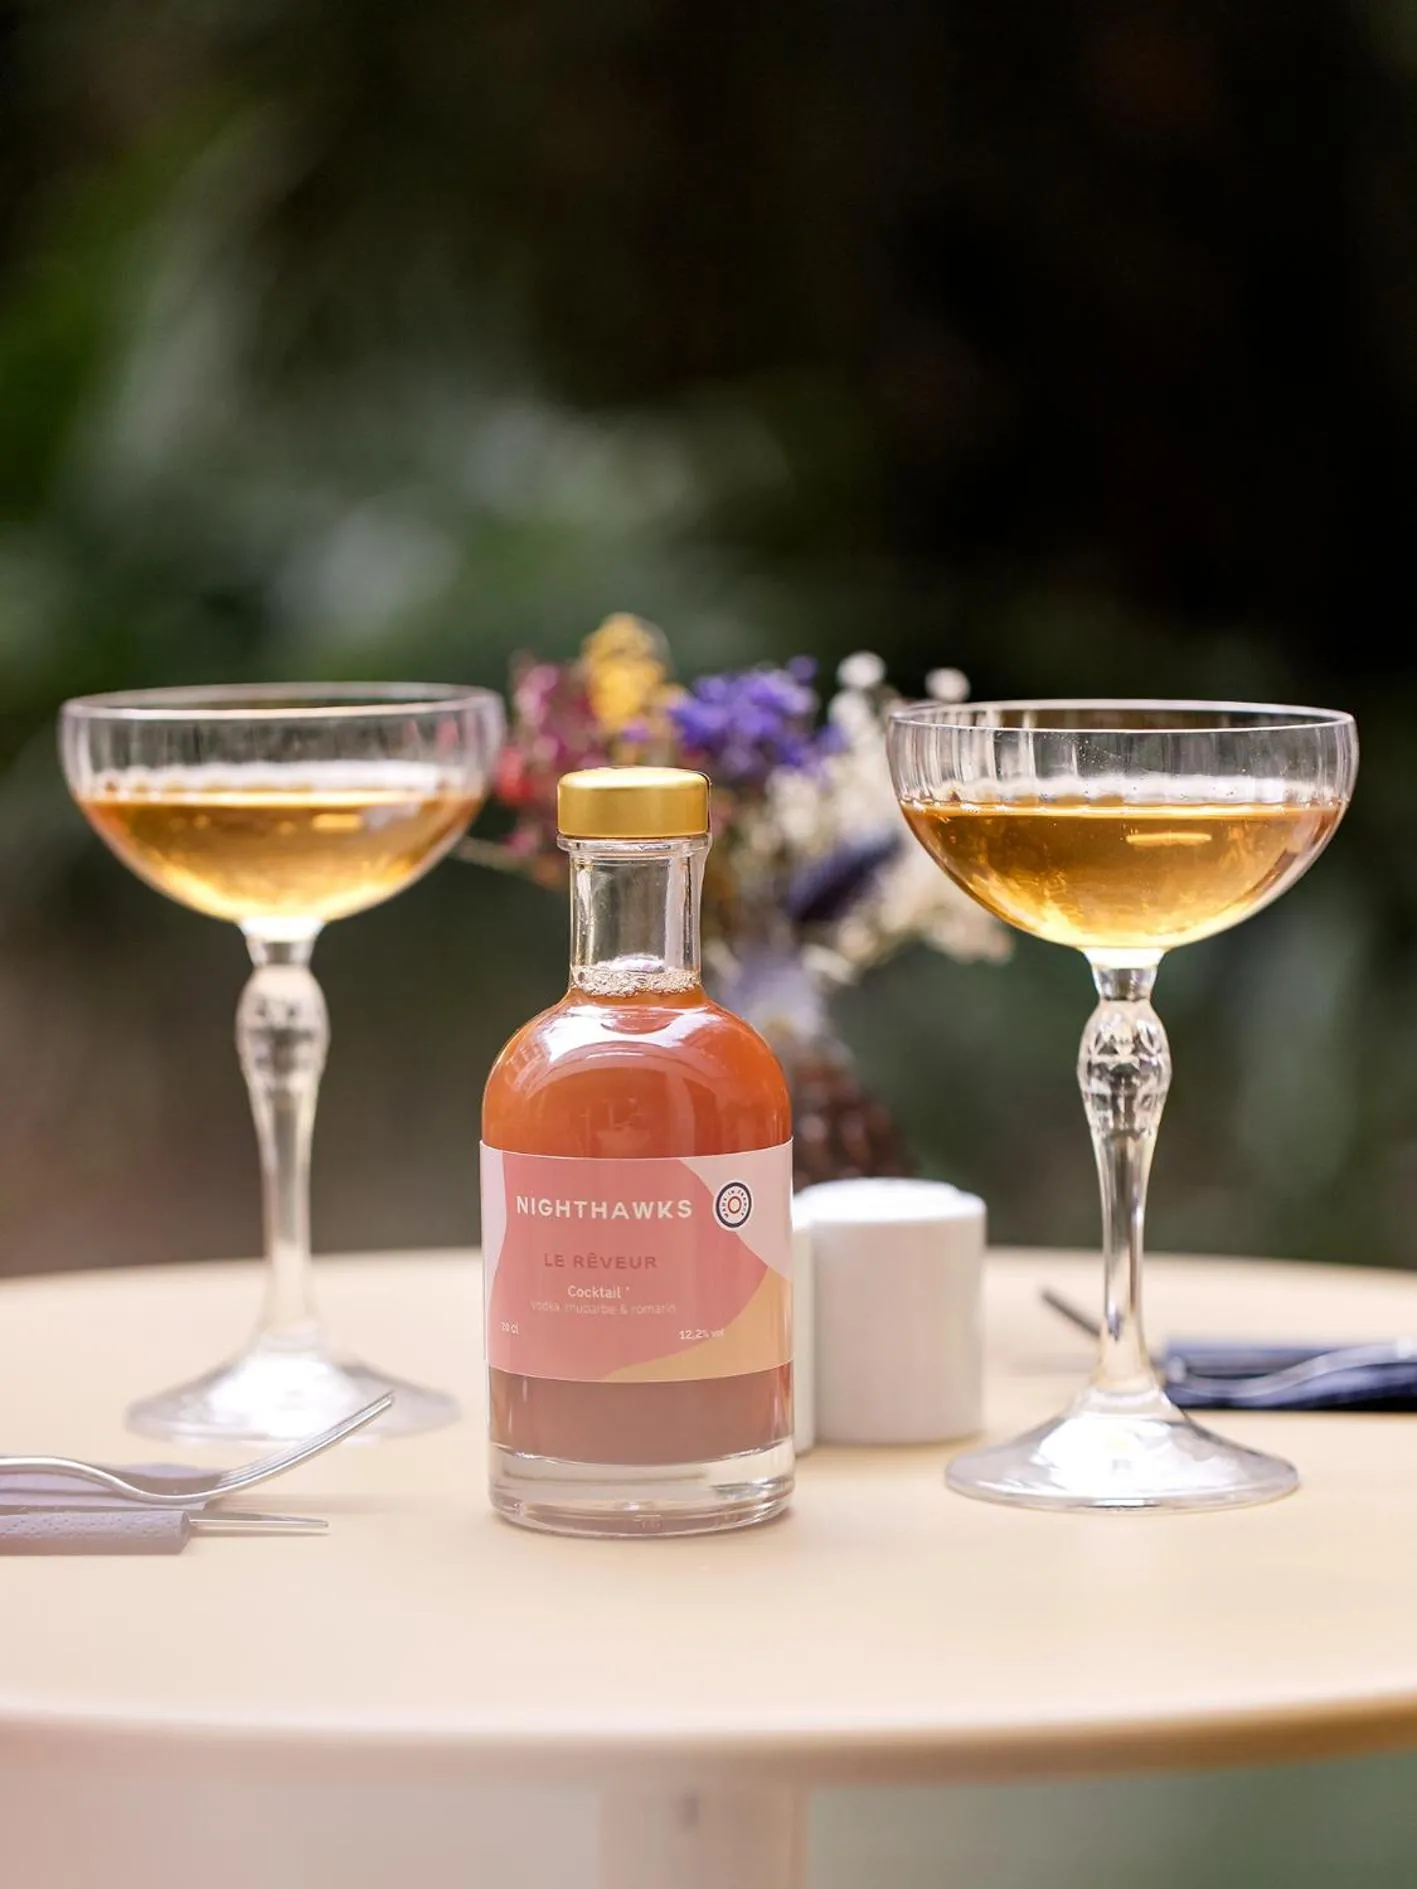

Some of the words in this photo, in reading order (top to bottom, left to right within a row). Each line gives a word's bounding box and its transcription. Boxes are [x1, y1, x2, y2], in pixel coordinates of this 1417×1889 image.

[516, 1195, 693, 1220] NIGHTHAWKS
[544, 1253, 566, 1268] LE
[573, 1253, 658, 1270] RÊVEUR
[567, 1285, 622, 1299] Cocktail
